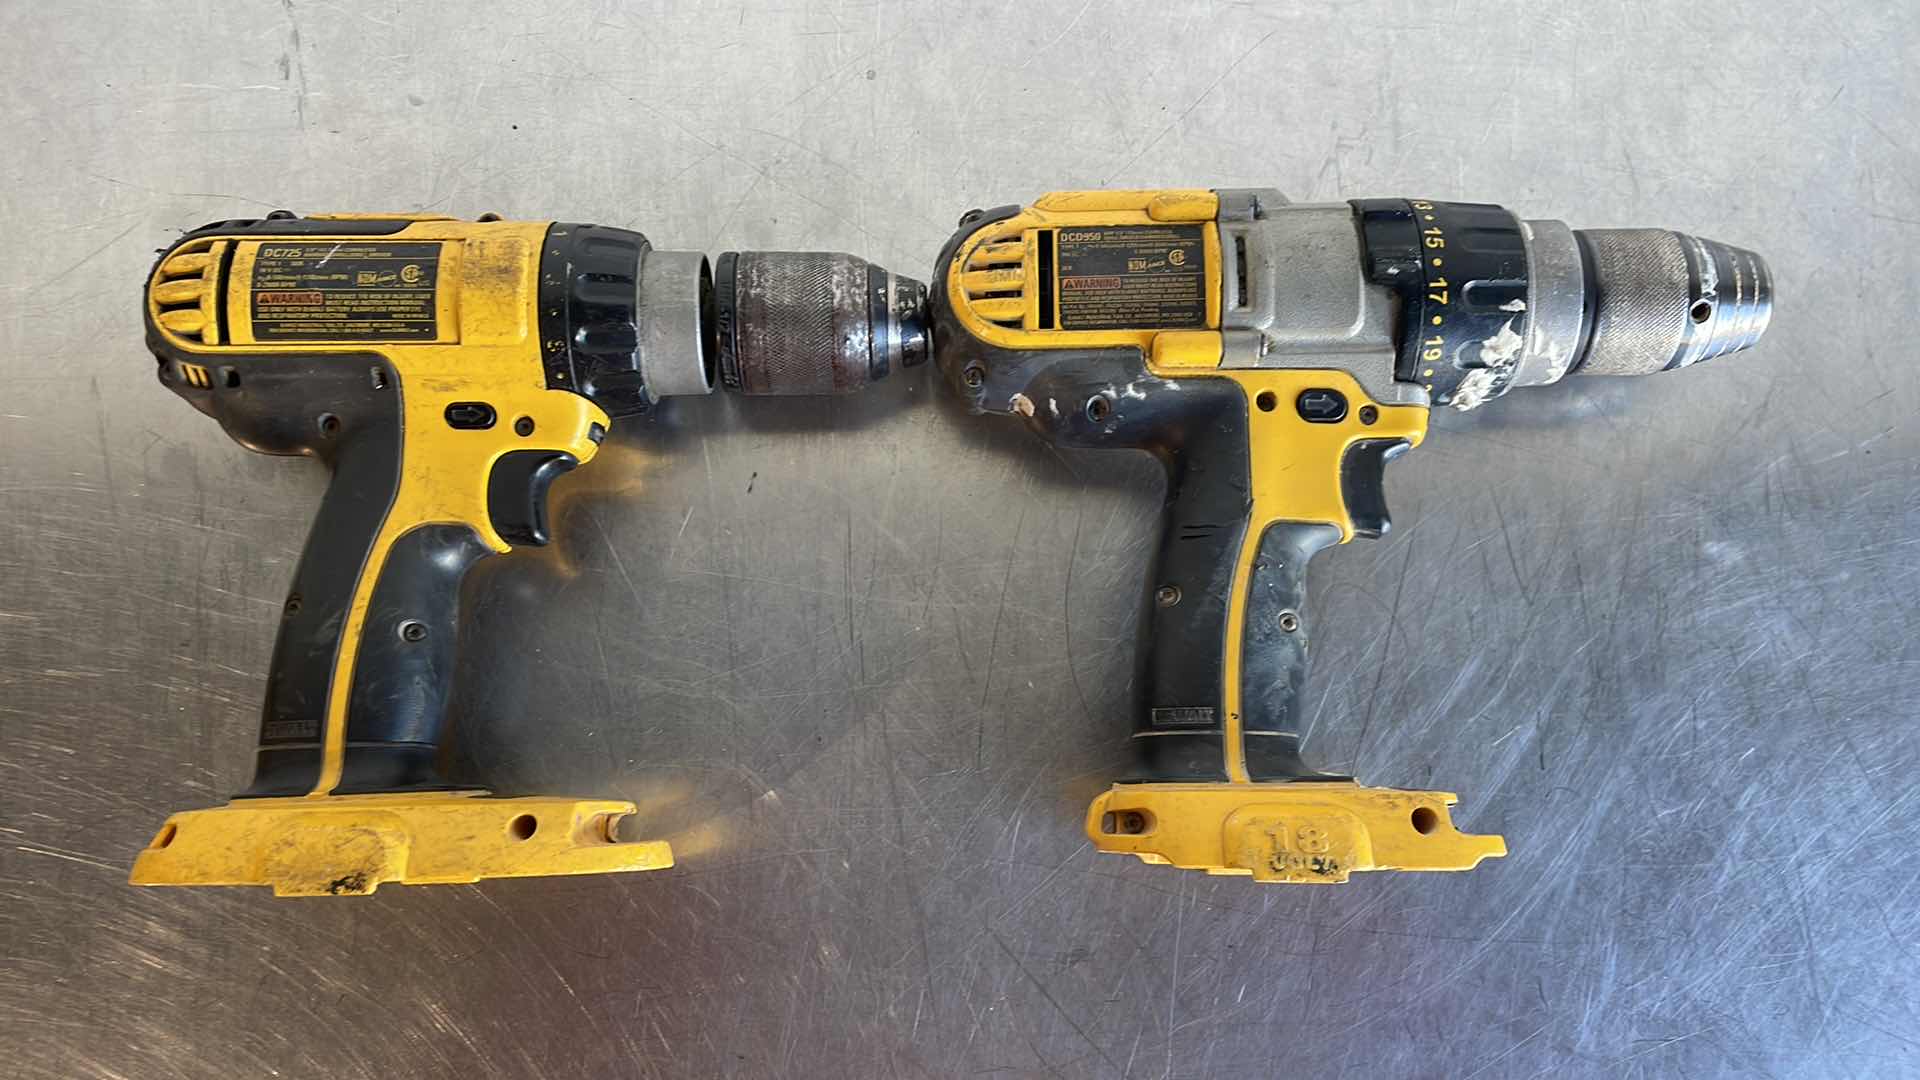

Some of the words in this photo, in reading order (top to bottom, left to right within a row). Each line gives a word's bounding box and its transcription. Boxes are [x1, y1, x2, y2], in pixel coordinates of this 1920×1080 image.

[1061, 232, 1102, 242] DCD950
[1424, 226, 1445, 248] 15
[263, 248, 303, 258] DC725
[1073, 278, 1120, 289] WARNING
[1429, 277, 1448, 304] 17
[270, 293, 322, 304] WARNING
[1423, 336, 1444, 361] 19
[1265, 823, 1330, 855] 18
